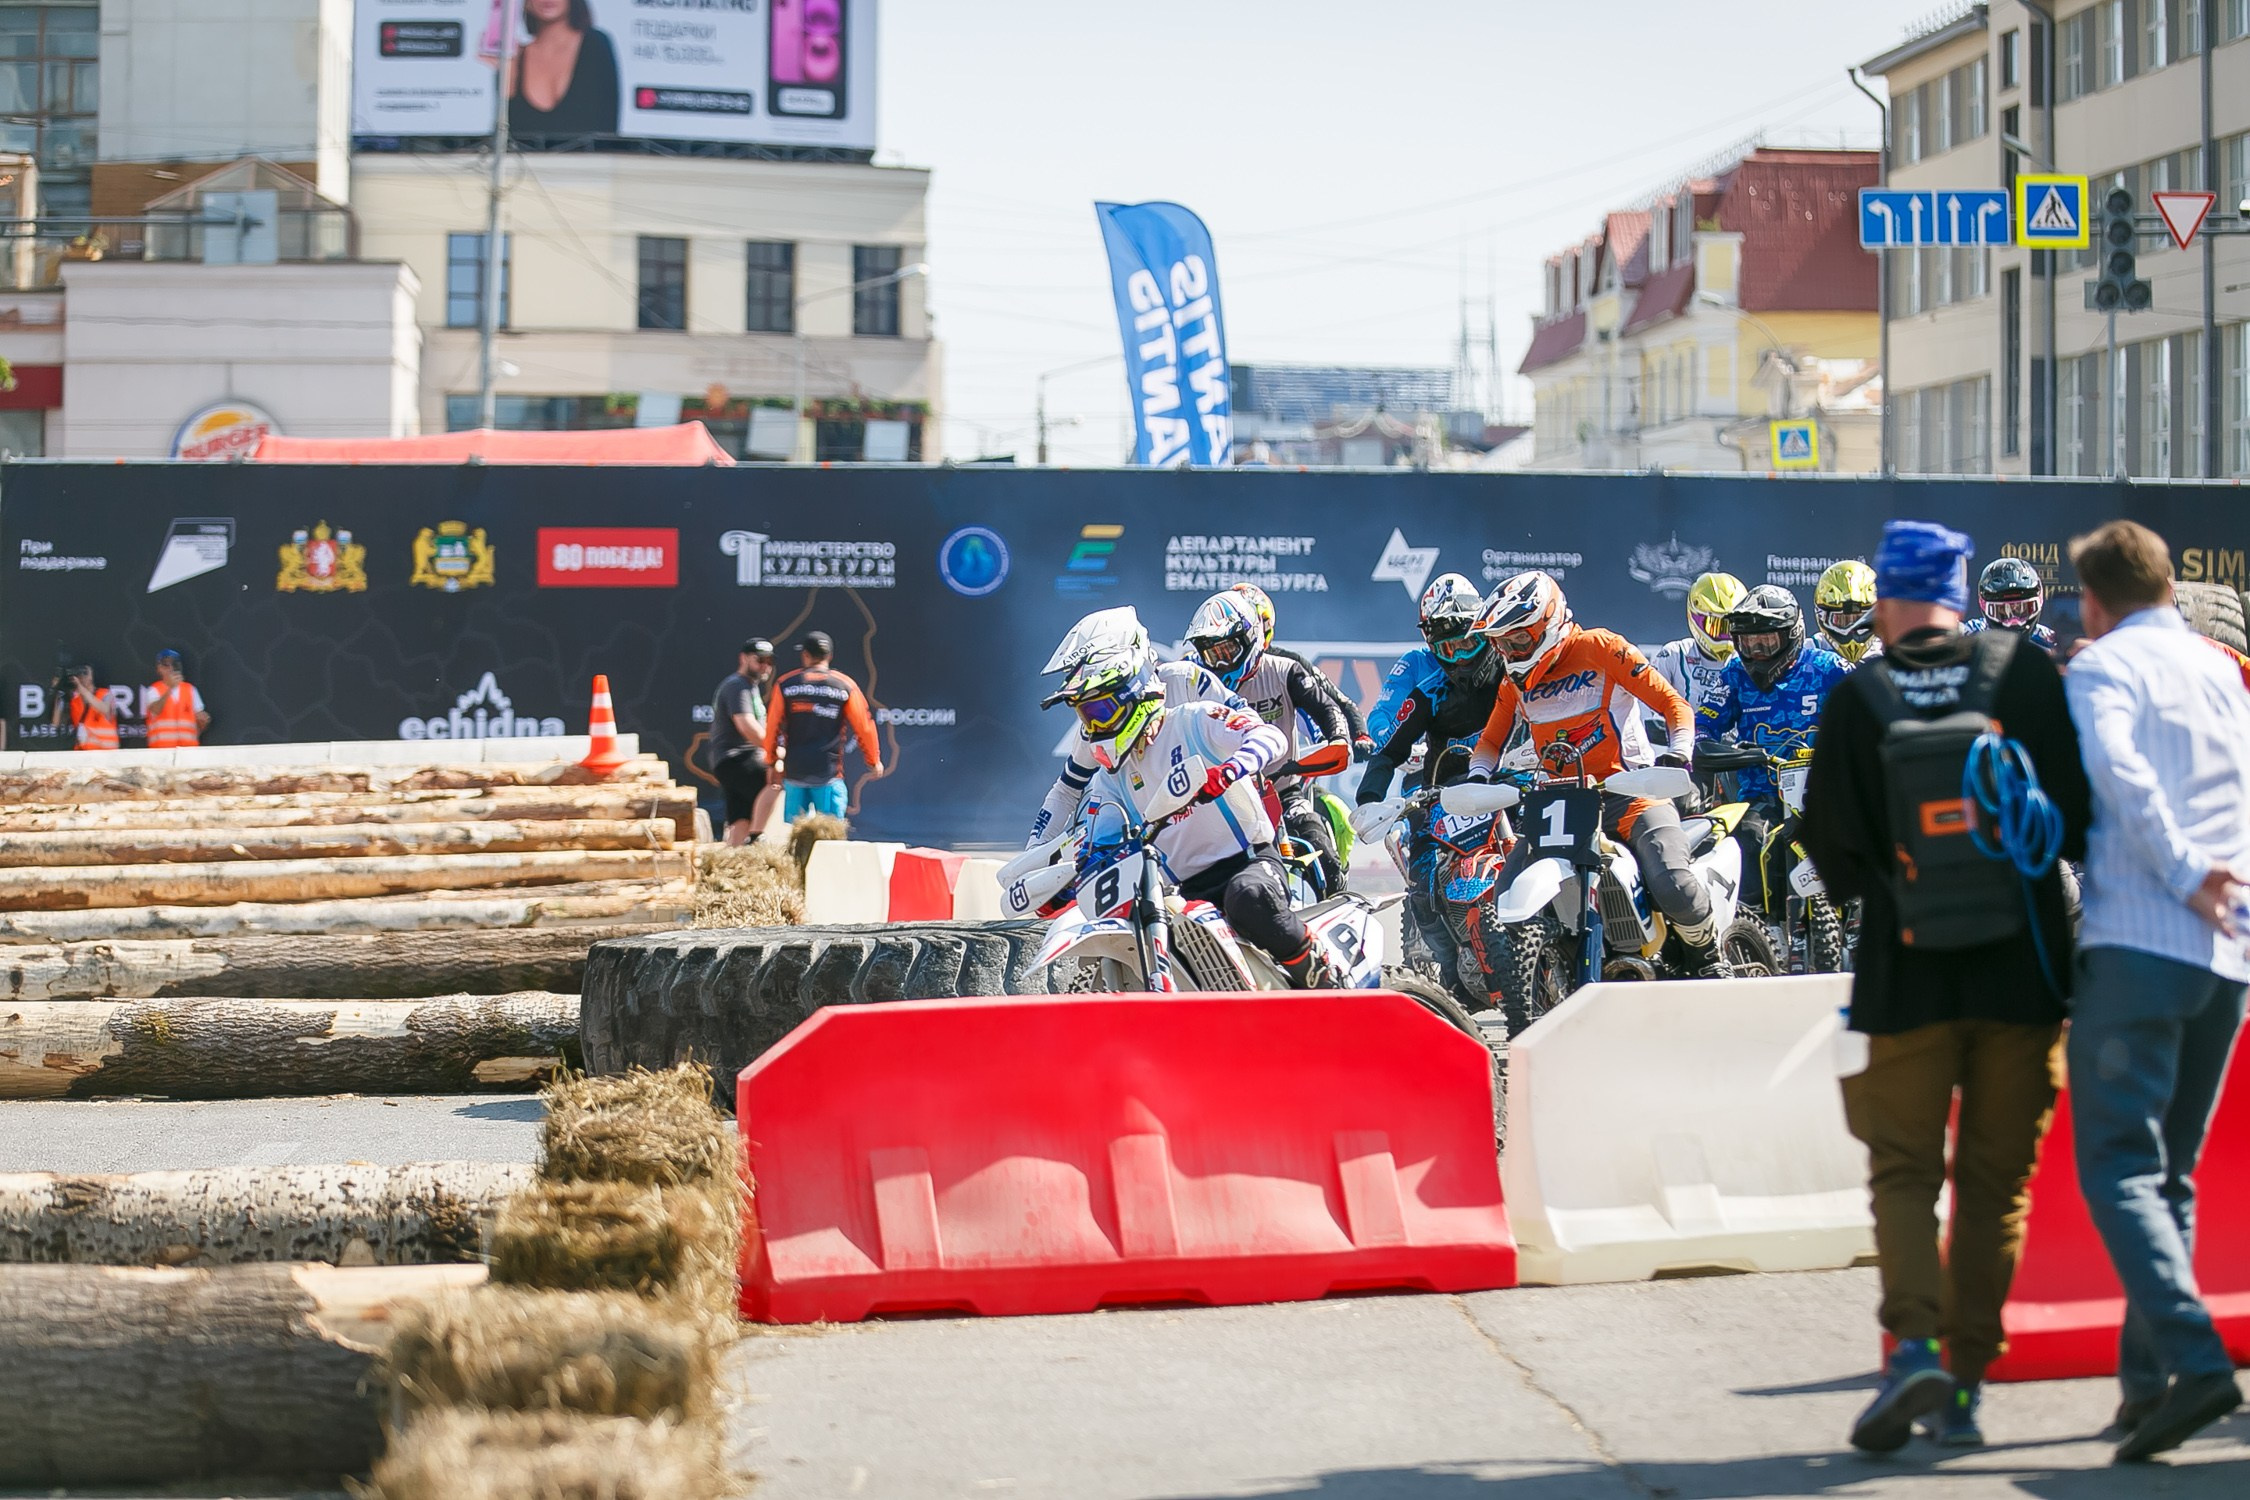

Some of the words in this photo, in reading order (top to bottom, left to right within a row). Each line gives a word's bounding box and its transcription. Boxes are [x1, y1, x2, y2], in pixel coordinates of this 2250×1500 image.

[763, 540, 896, 559] МИНИСТЕРСТВО
[1165, 536, 1315, 555] ДЕПАРТАМЕНТ
[2001, 542, 2060, 566] ФОНД
[763, 558, 896, 575] КУЛЬТУРЫ
[1165, 554, 1276, 573] КУЛЬТУРЫ
[1482, 549, 1582, 567] Организатор
[1766, 571, 1821, 587] партне
[1062, 642, 1096, 667] AIROH
[1801, 694, 1819, 716] 5
[398, 708, 566, 740] echidna
[876, 708, 957, 725] РОССИИ
[1539, 799, 1574, 847] 1
[1094, 867, 1121, 918] 8
